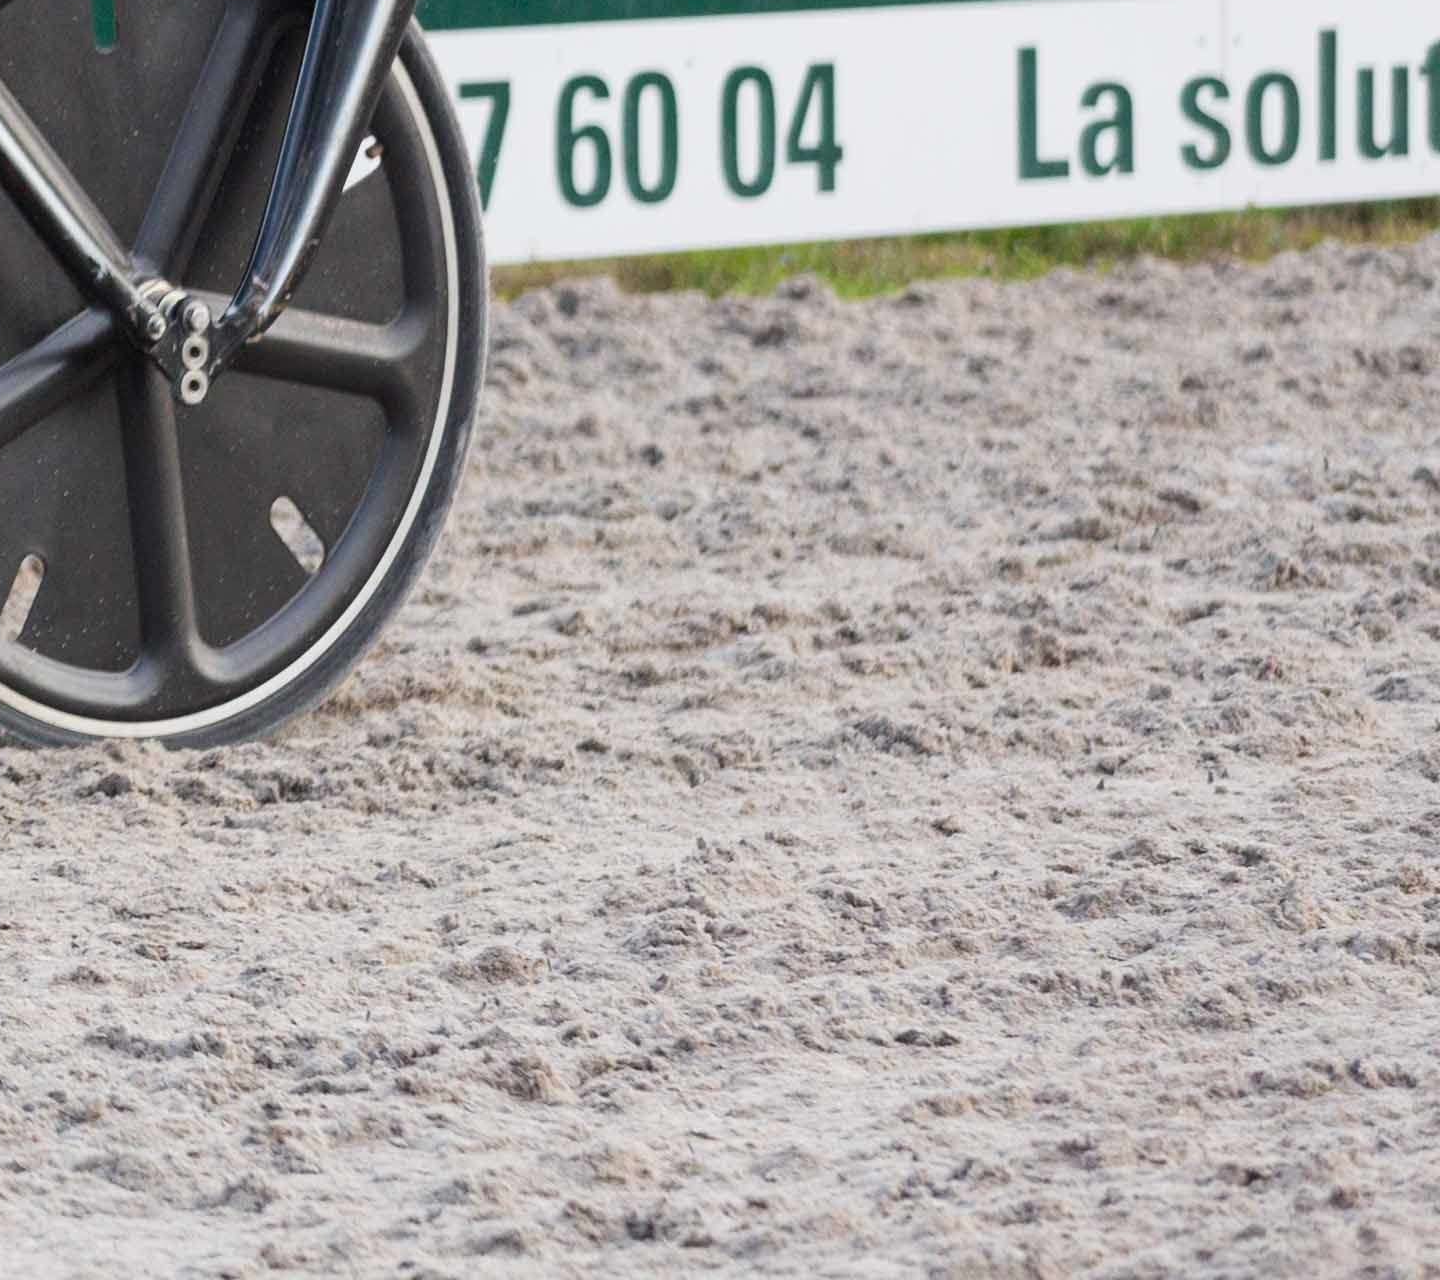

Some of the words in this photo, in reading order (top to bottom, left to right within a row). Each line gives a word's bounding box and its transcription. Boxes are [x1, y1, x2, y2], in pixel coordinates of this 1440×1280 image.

[458, 79, 512, 211] 7
[555, 71, 680, 209] 60
[719, 62, 844, 199] 04
[1016, 45, 1136, 181] La
